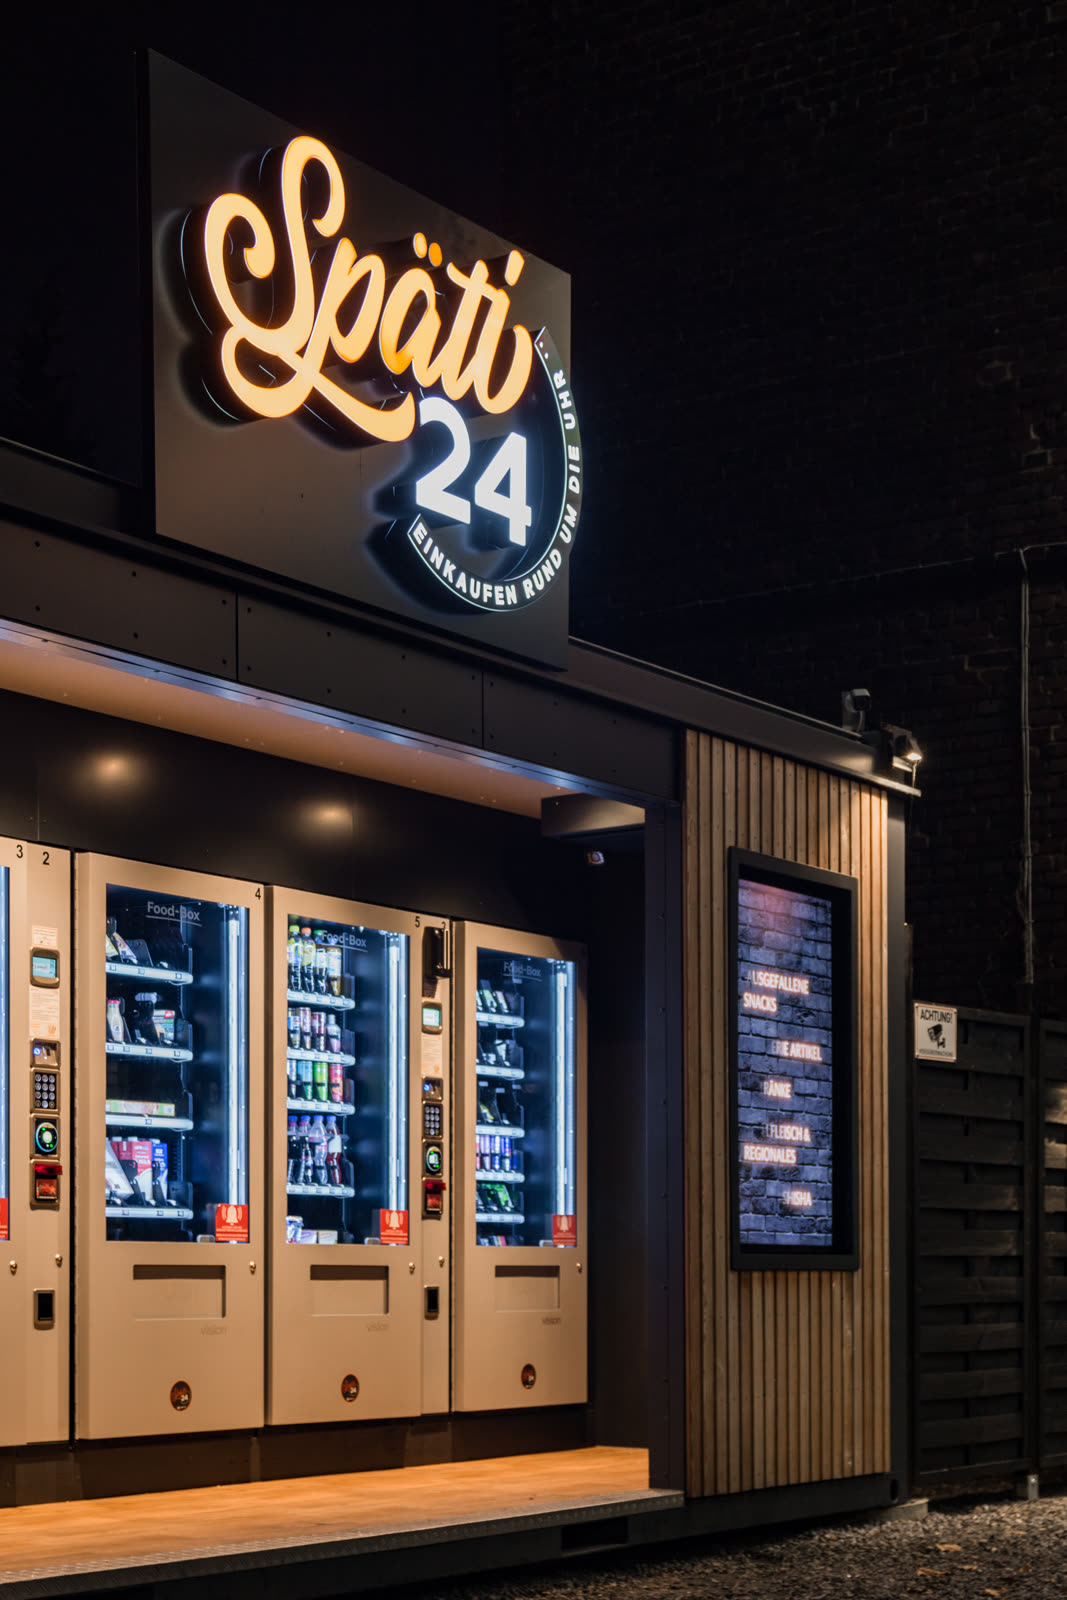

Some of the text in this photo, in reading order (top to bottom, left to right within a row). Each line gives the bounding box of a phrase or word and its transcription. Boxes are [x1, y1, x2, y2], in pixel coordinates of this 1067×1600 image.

[205, 136, 532, 441] Späti
[416, 397, 532, 547] 24
[413, 369, 580, 605] EINKAUFEN RUND UM DIE UHR
[16, 844, 23, 858] 3
[42, 852, 50, 865] 2
[255, 887, 262, 900] 4
[147, 901, 200, 922] Food-Box
[414, 915, 421, 929] 5
[743, 992, 777, 1012] SNACKS
[743, 1144, 797, 1164] REGIONALES
